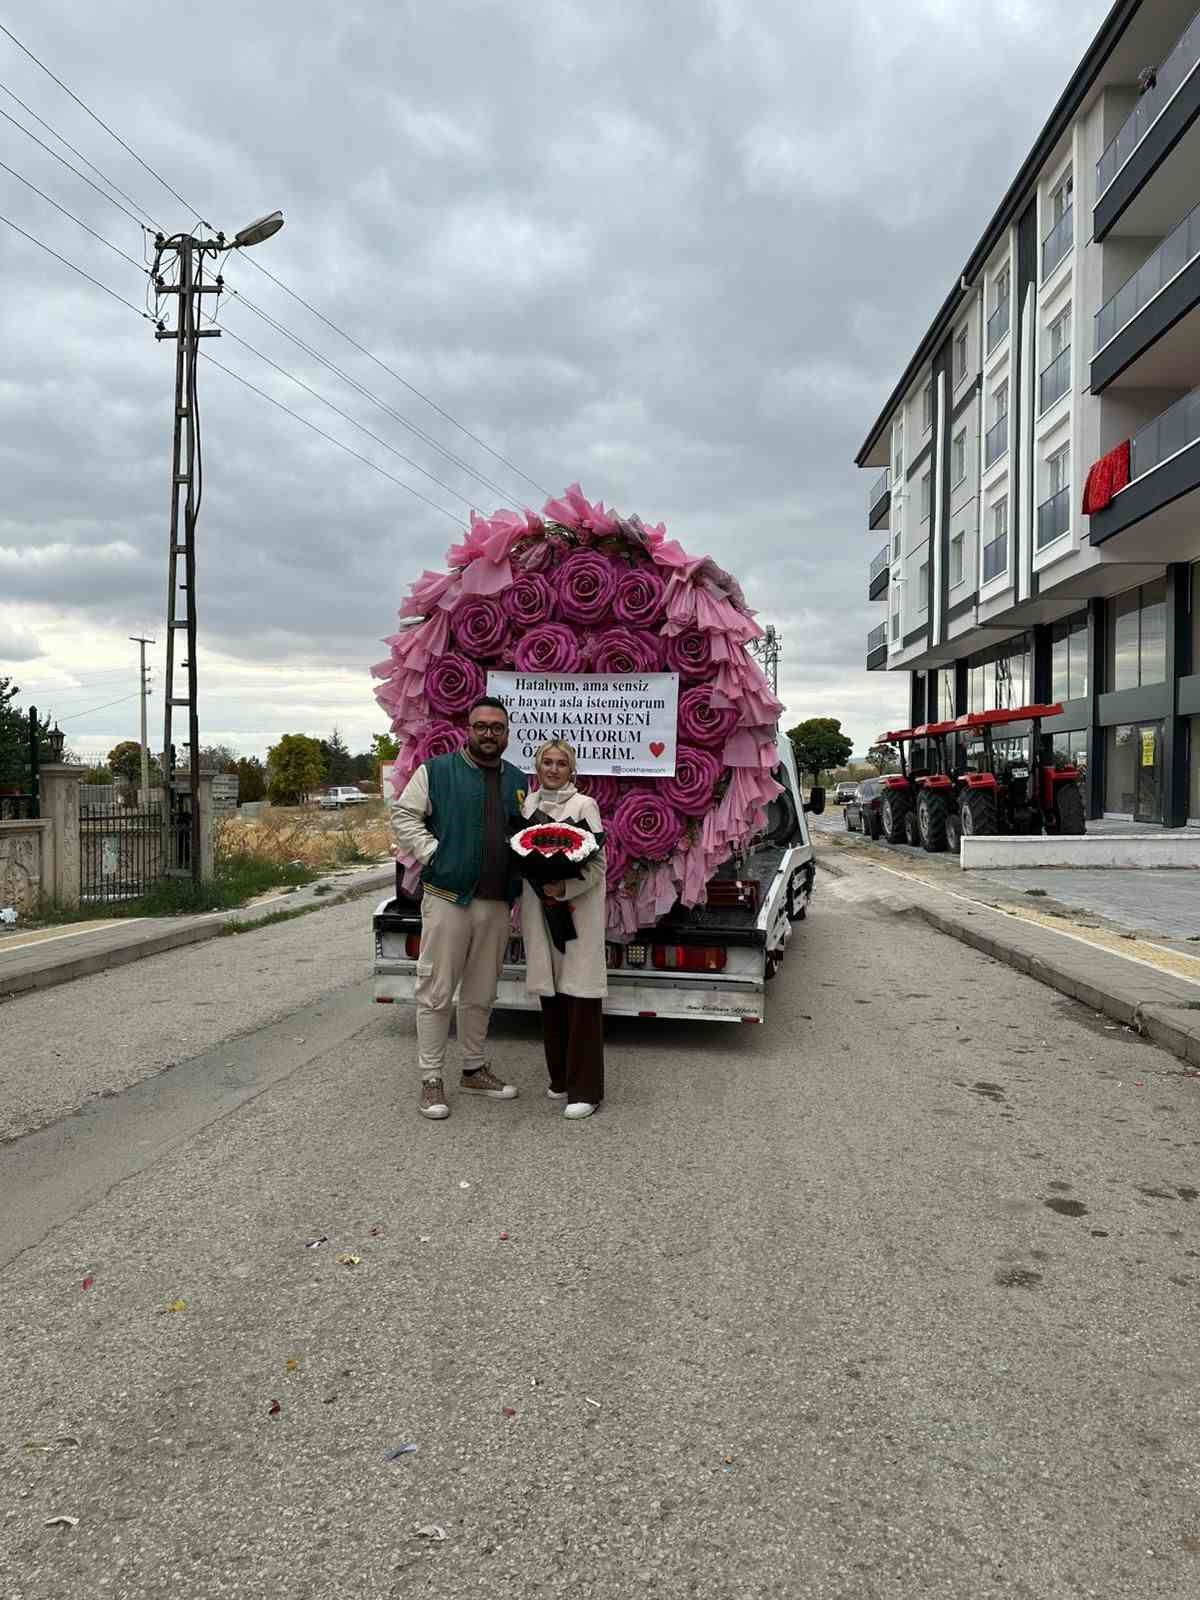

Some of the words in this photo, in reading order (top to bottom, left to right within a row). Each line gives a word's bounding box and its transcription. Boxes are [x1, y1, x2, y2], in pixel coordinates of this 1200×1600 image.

[515, 678, 578, 694] Hatalıyım,
[583, 682, 609, 692] ama
[612, 679, 649, 692] sensiz
[498, 695, 515, 708] bir
[519, 695, 556, 711] hayatı
[559, 695, 583, 708] asla
[586, 696, 665, 711] istemiyorum
[510, 711, 558, 724] CANIM
[562, 712, 612, 726] KARIM
[617, 711, 650, 726] SENİ
[517, 728, 548, 743] ÇOK
[552, 727, 641, 743] SEVİYORUM
